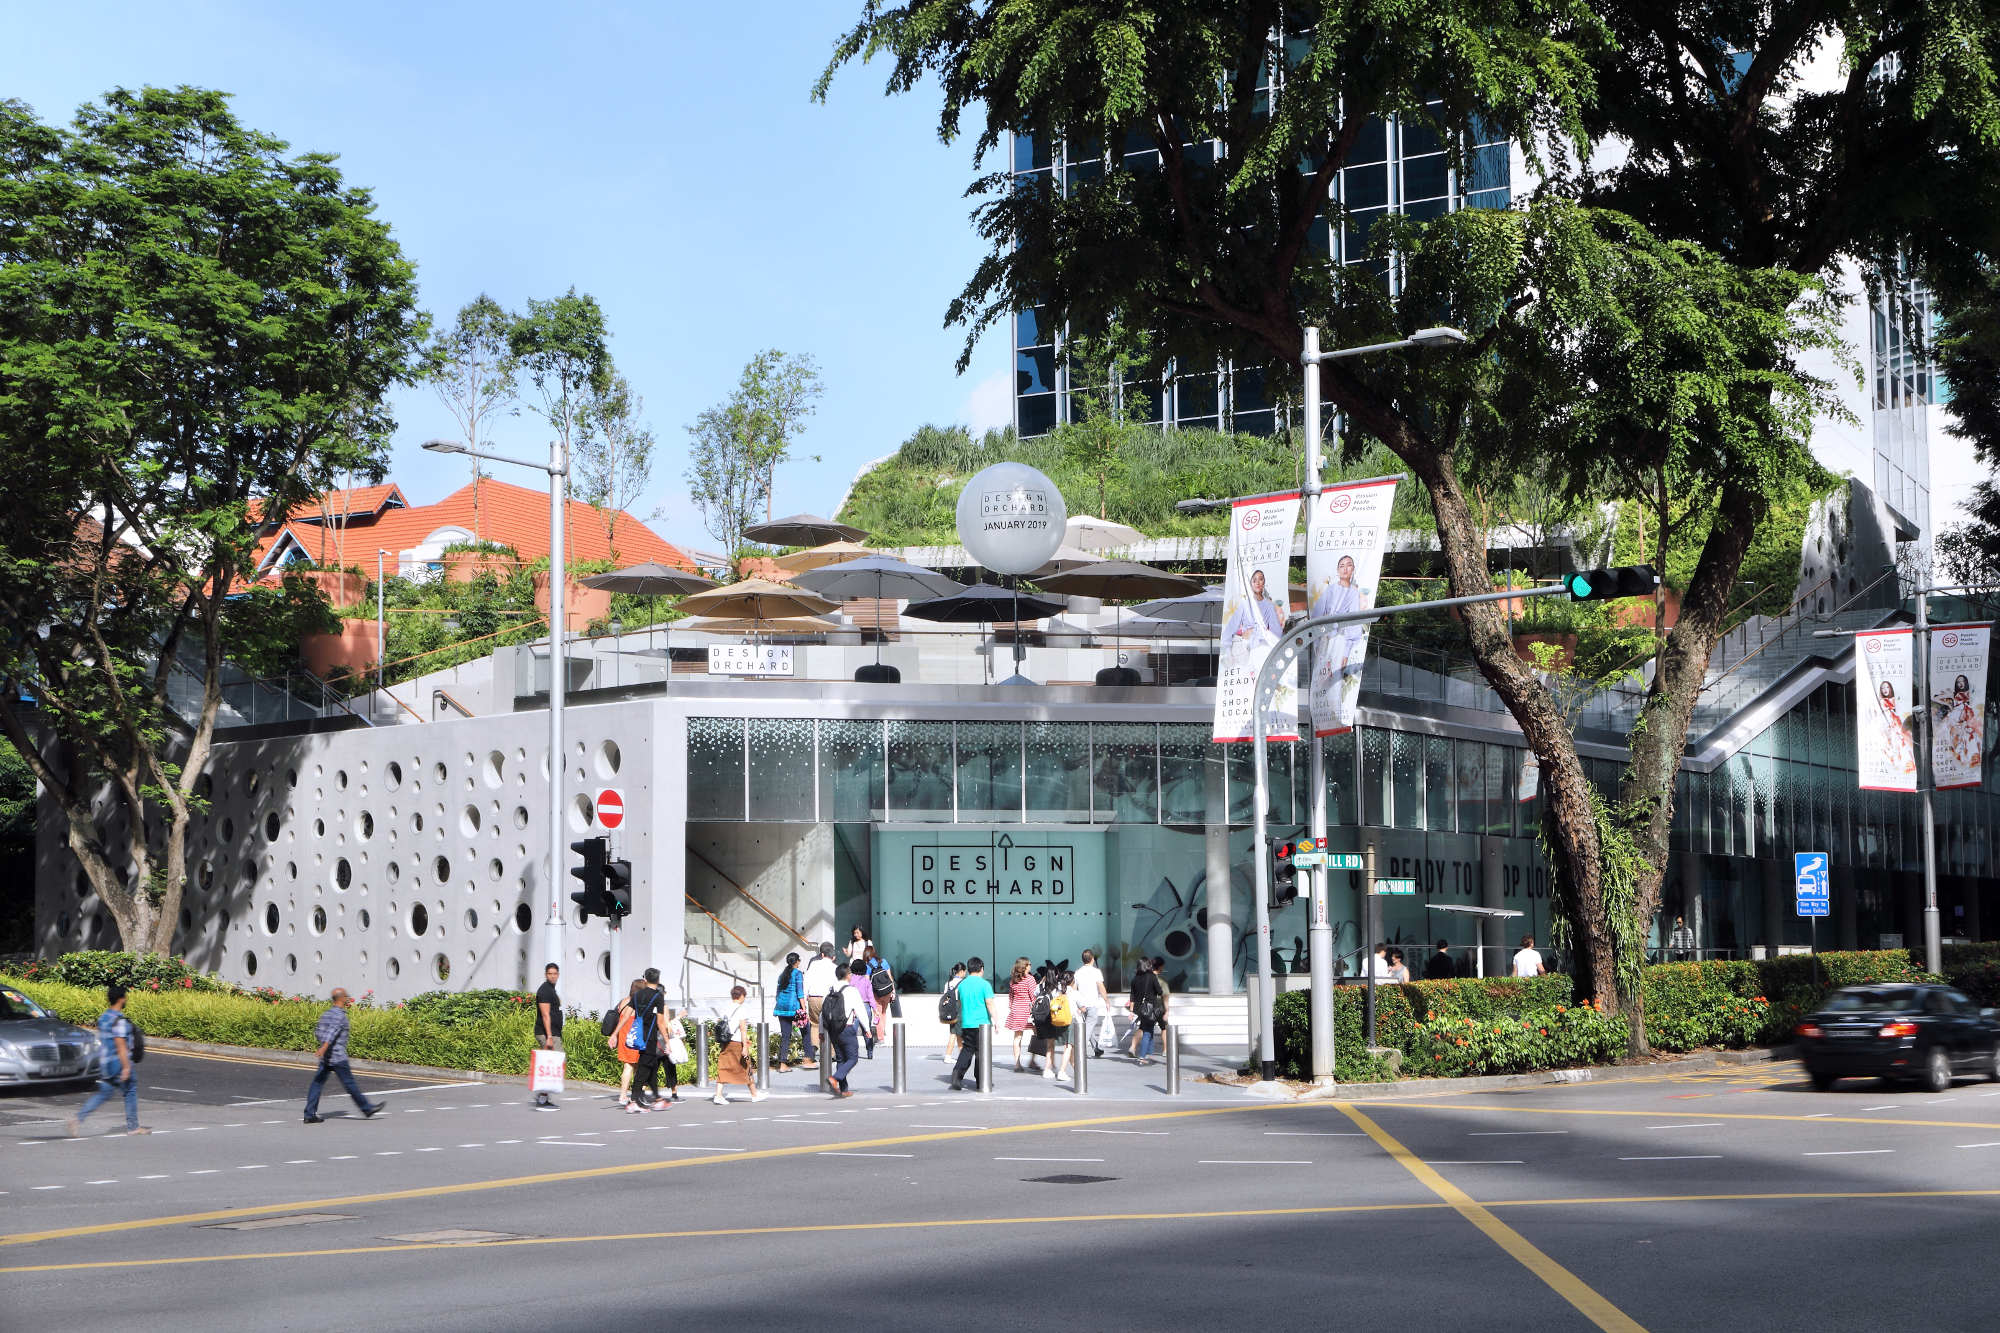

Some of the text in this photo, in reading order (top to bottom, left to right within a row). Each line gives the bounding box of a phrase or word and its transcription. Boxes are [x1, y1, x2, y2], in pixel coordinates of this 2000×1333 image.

[984, 504, 1044, 513] ORCHARD
[1333, 499, 1348, 508] SG
[984, 521, 1047, 531] JANUARY 2019
[1244, 515, 1258, 526] SG
[713, 647, 789, 658] DESIGN
[713, 660, 789, 671] ORCHARD
[1224, 668, 1241, 677] GET
[1223, 677, 1256, 687] READY
[1223, 689, 1234, 697] TO
[1222, 698, 1249, 708] SHOP
[922, 854, 1064, 871] DESIGN
[1346, 855, 1358, 867] RD
[1452, 861, 1473, 895] TO
[922, 879, 1064, 895] ORCHARD
[1380, 880, 1414, 893] ORCHARD RD
[538, 1065, 562, 1078] SALE
